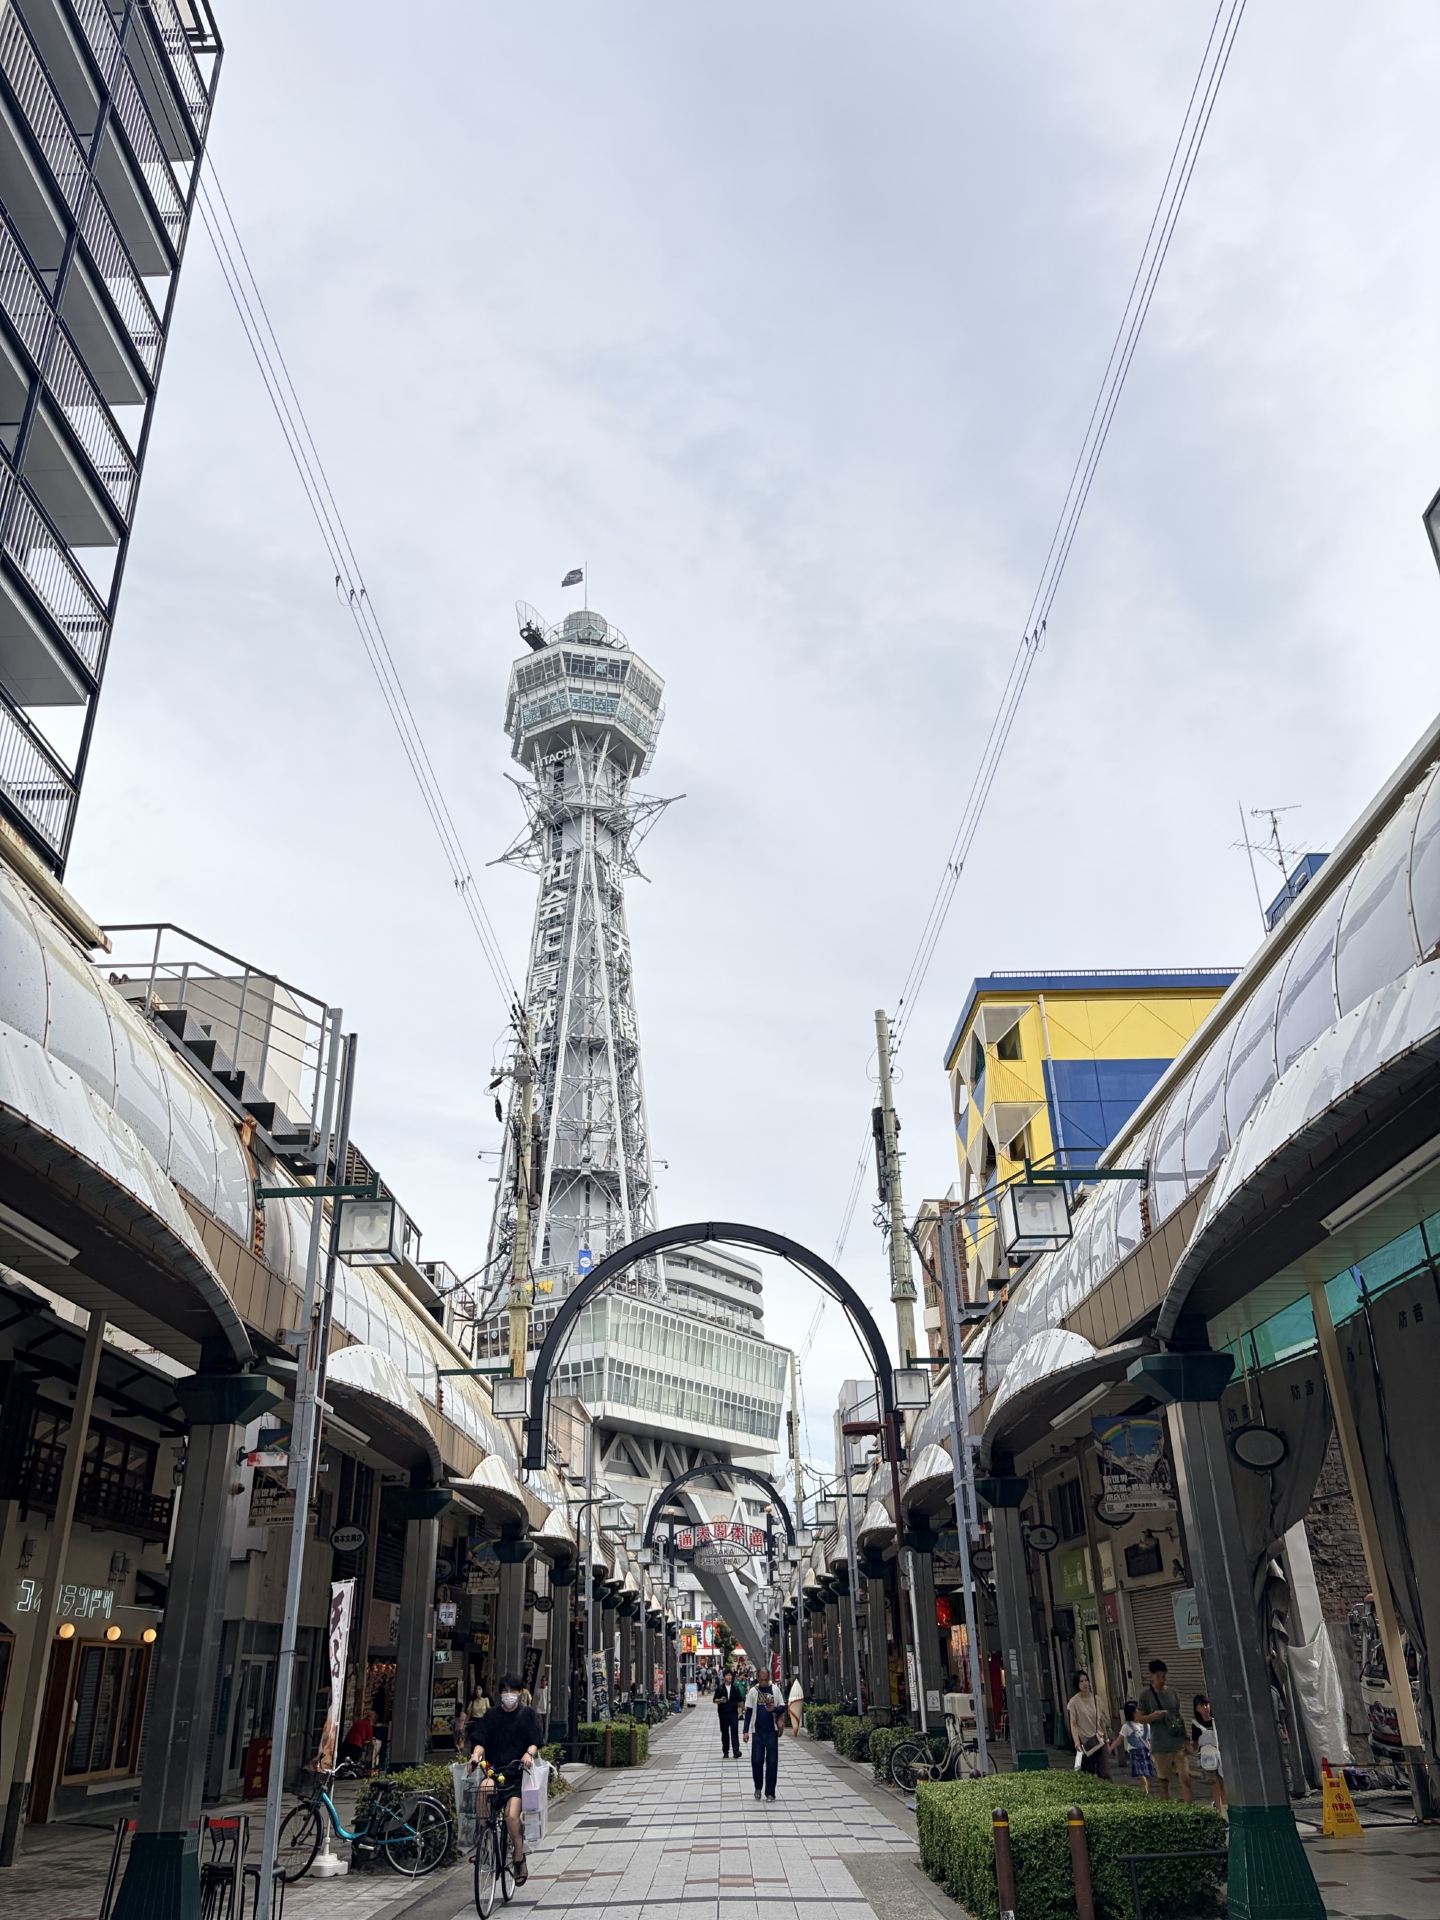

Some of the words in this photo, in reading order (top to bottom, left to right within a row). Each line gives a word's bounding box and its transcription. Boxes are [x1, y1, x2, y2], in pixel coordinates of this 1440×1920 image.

[532, 746, 576, 768] HITACHI
[1398, 1303, 1425, 1330] 防音
[1290, 1380, 1315, 1401] 防音
[678, 1522, 764, 1550] 通天閣本通
